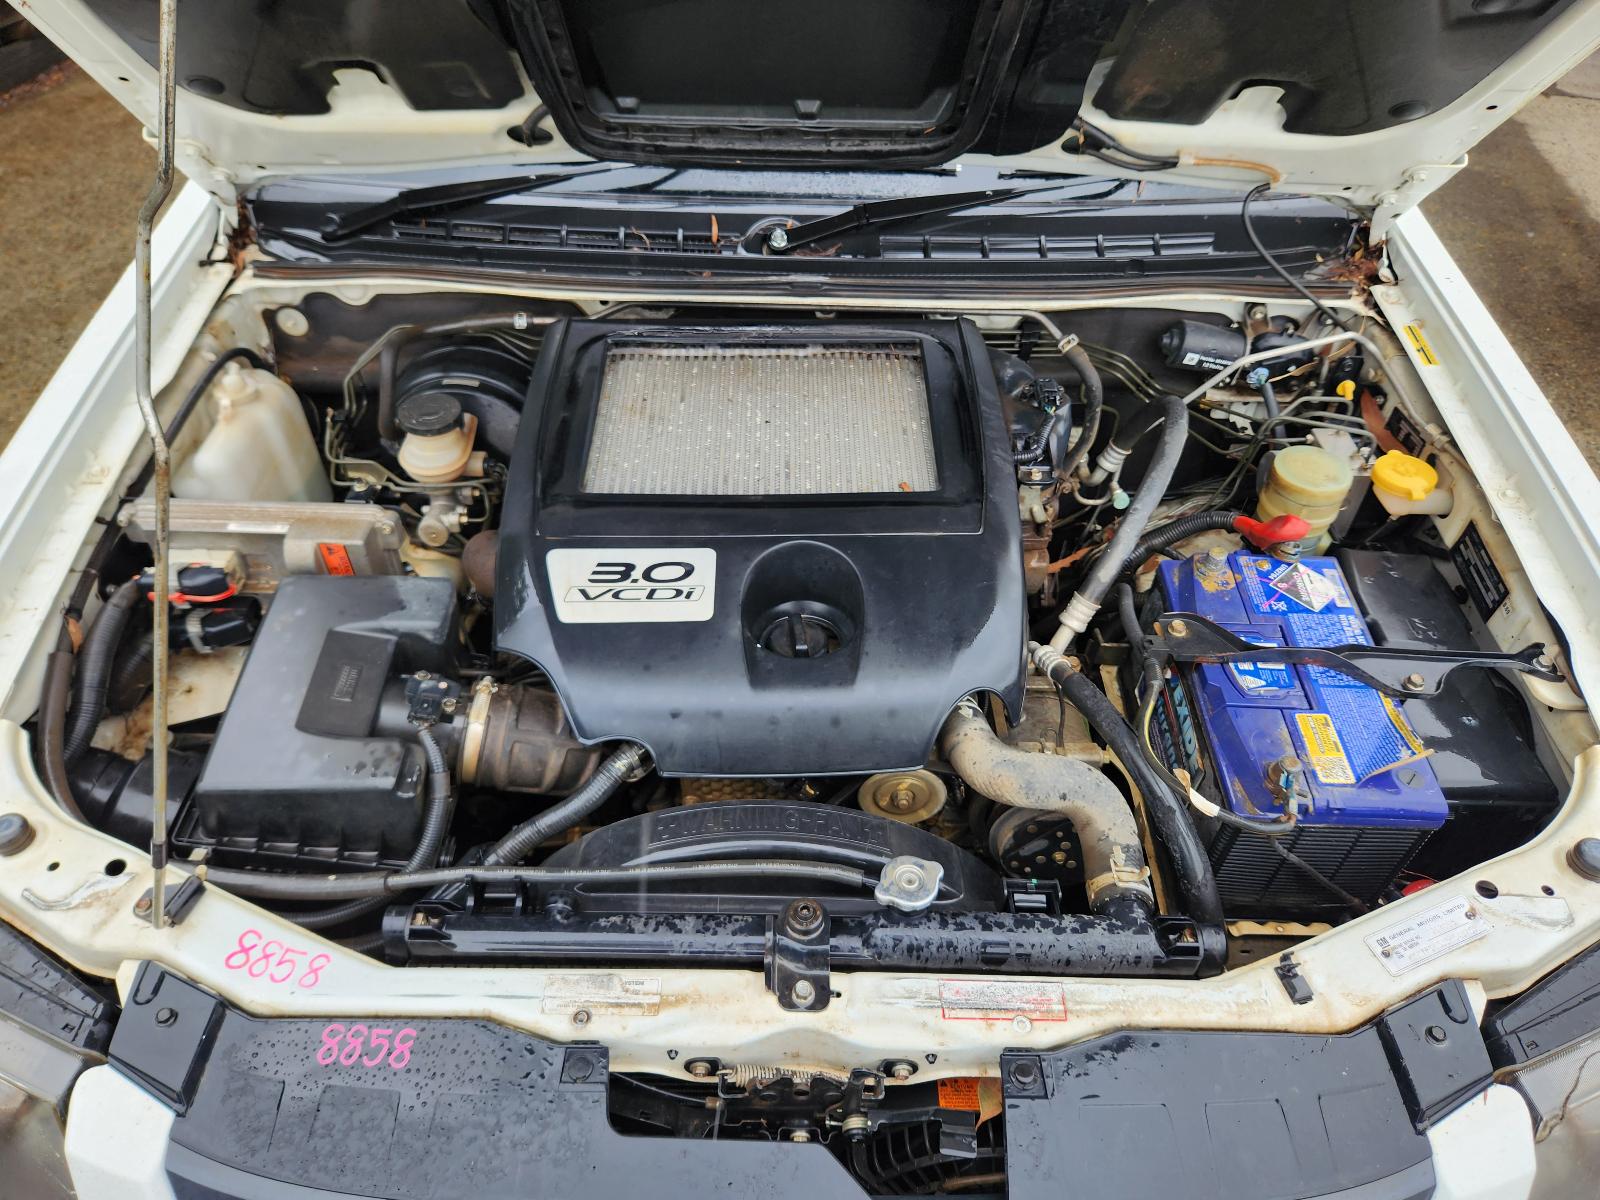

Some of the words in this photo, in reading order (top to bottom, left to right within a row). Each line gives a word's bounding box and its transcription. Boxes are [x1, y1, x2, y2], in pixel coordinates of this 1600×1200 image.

[587, 561, 695, 584] 3.0
[577, 587, 696, 601] VCDi
[1173, 684, 1201, 776] EXIDE
[1376, 935, 1390, 948] GM
[1388, 926, 1415, 941] GENERAL
[224, 928, 333, 989] 8858
[316, 1023, 417, 1069] 8858
